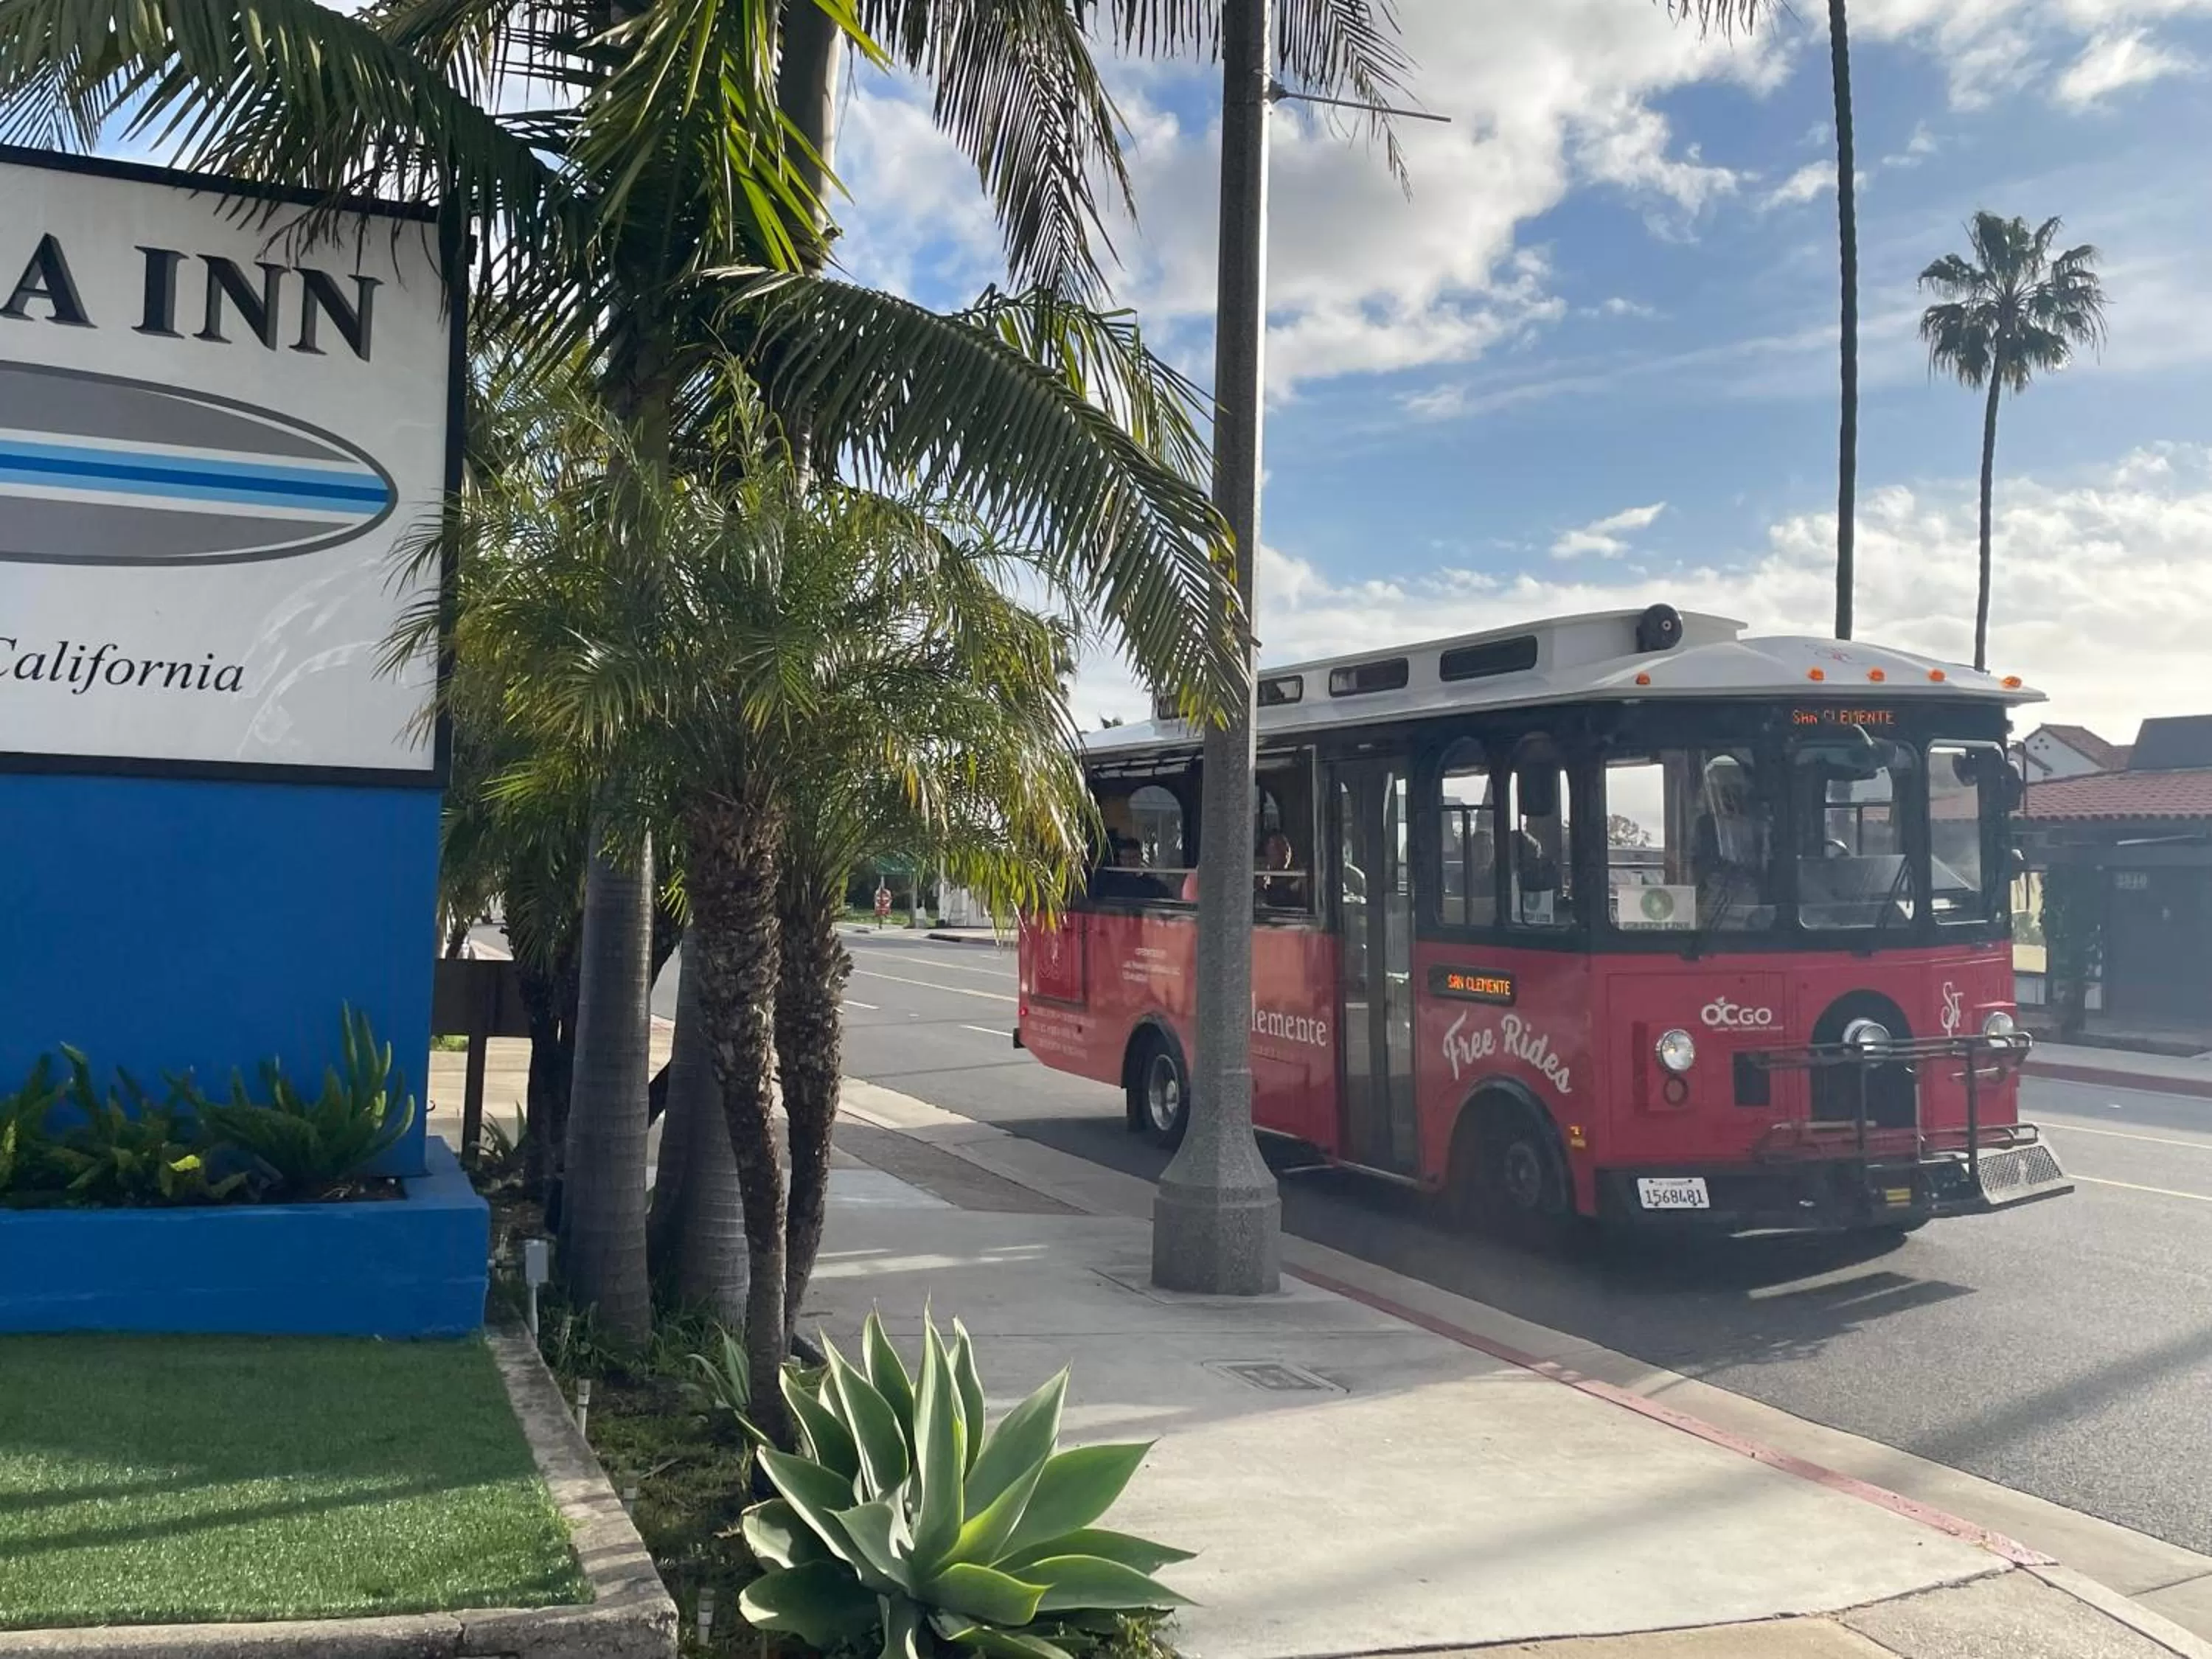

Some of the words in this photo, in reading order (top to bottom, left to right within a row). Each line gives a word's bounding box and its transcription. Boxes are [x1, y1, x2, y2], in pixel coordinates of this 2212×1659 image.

[0, 232, 98, 329] A
[131, 245, 384, 362] INN
[1447, 973, 1464, 990] SAN
[1465, 976, 1511, 996] CLEMENTE
[1443, 1009, 1497, 1080] Free
[1501, 1014, 1572, 1093] Rides
